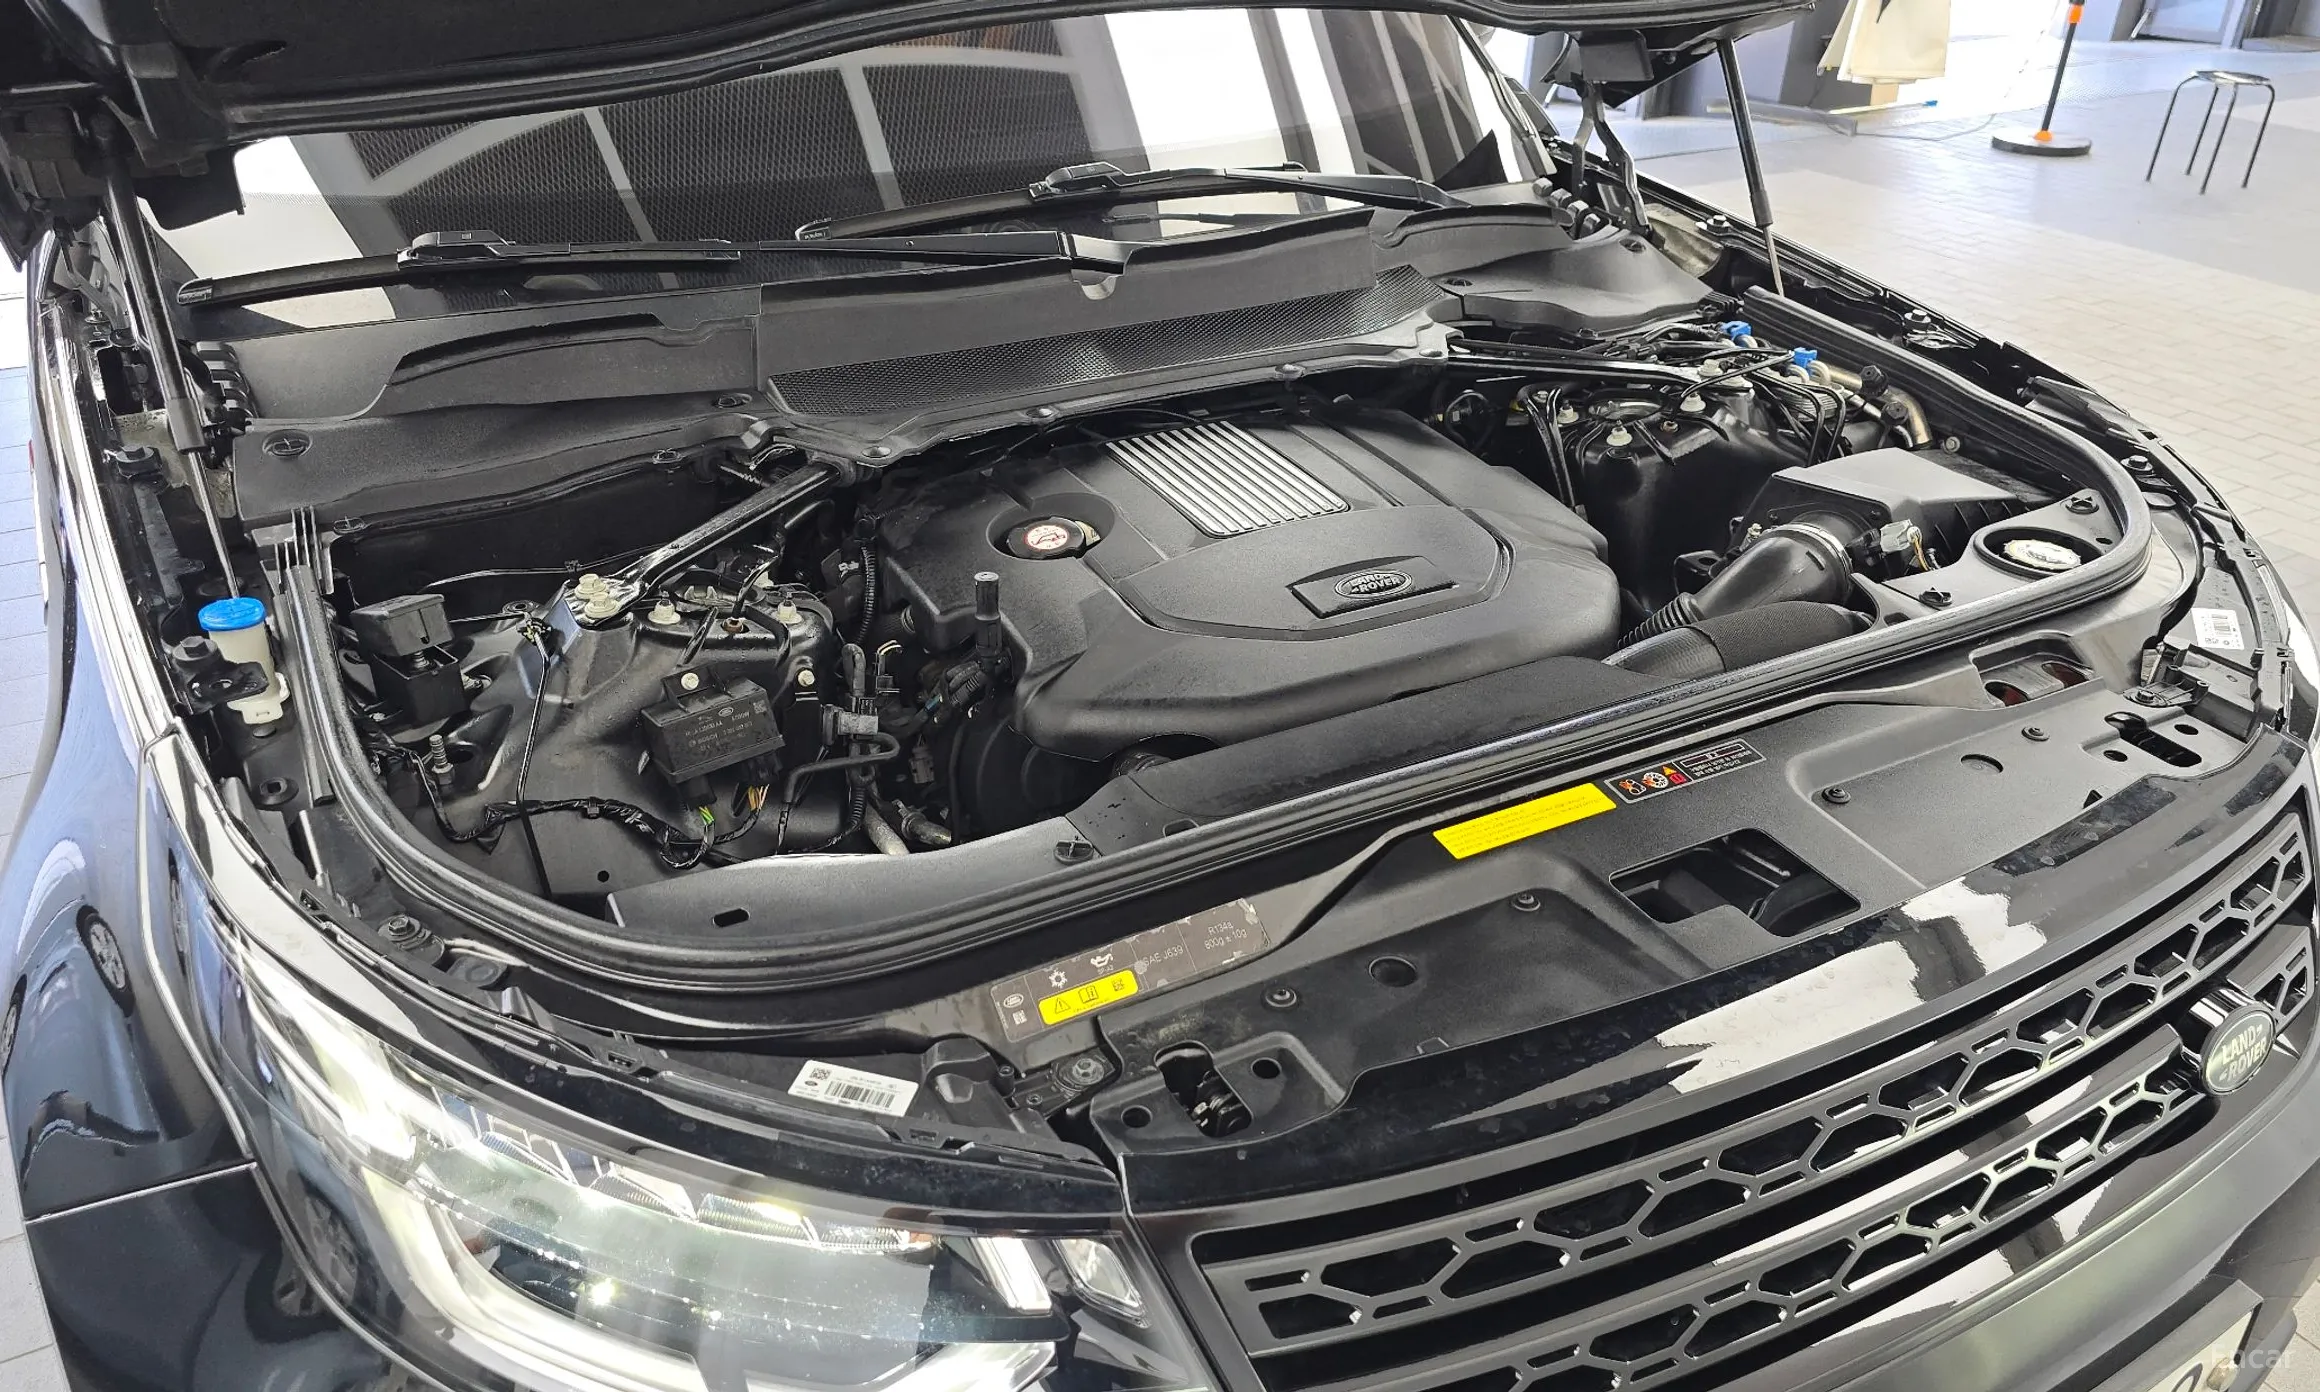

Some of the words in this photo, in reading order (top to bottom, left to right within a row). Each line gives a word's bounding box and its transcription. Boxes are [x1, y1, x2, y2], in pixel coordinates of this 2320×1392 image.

[1350, 573, 1384, 587] LAND
[1359, 576, 1400, 593] ROVER
[1204, 936, 1225, 950] 800g
[1232, 928, 1248, 941] 10g
[1208, 921, 1234, 935] R134a
[1142, 952, 1162, 967] SAE
[1163, 945, 1184, 960] J639
[2221, 1025, 2257, 1065] LAND
[2228, 1036, 2267, 1080] ROVER
